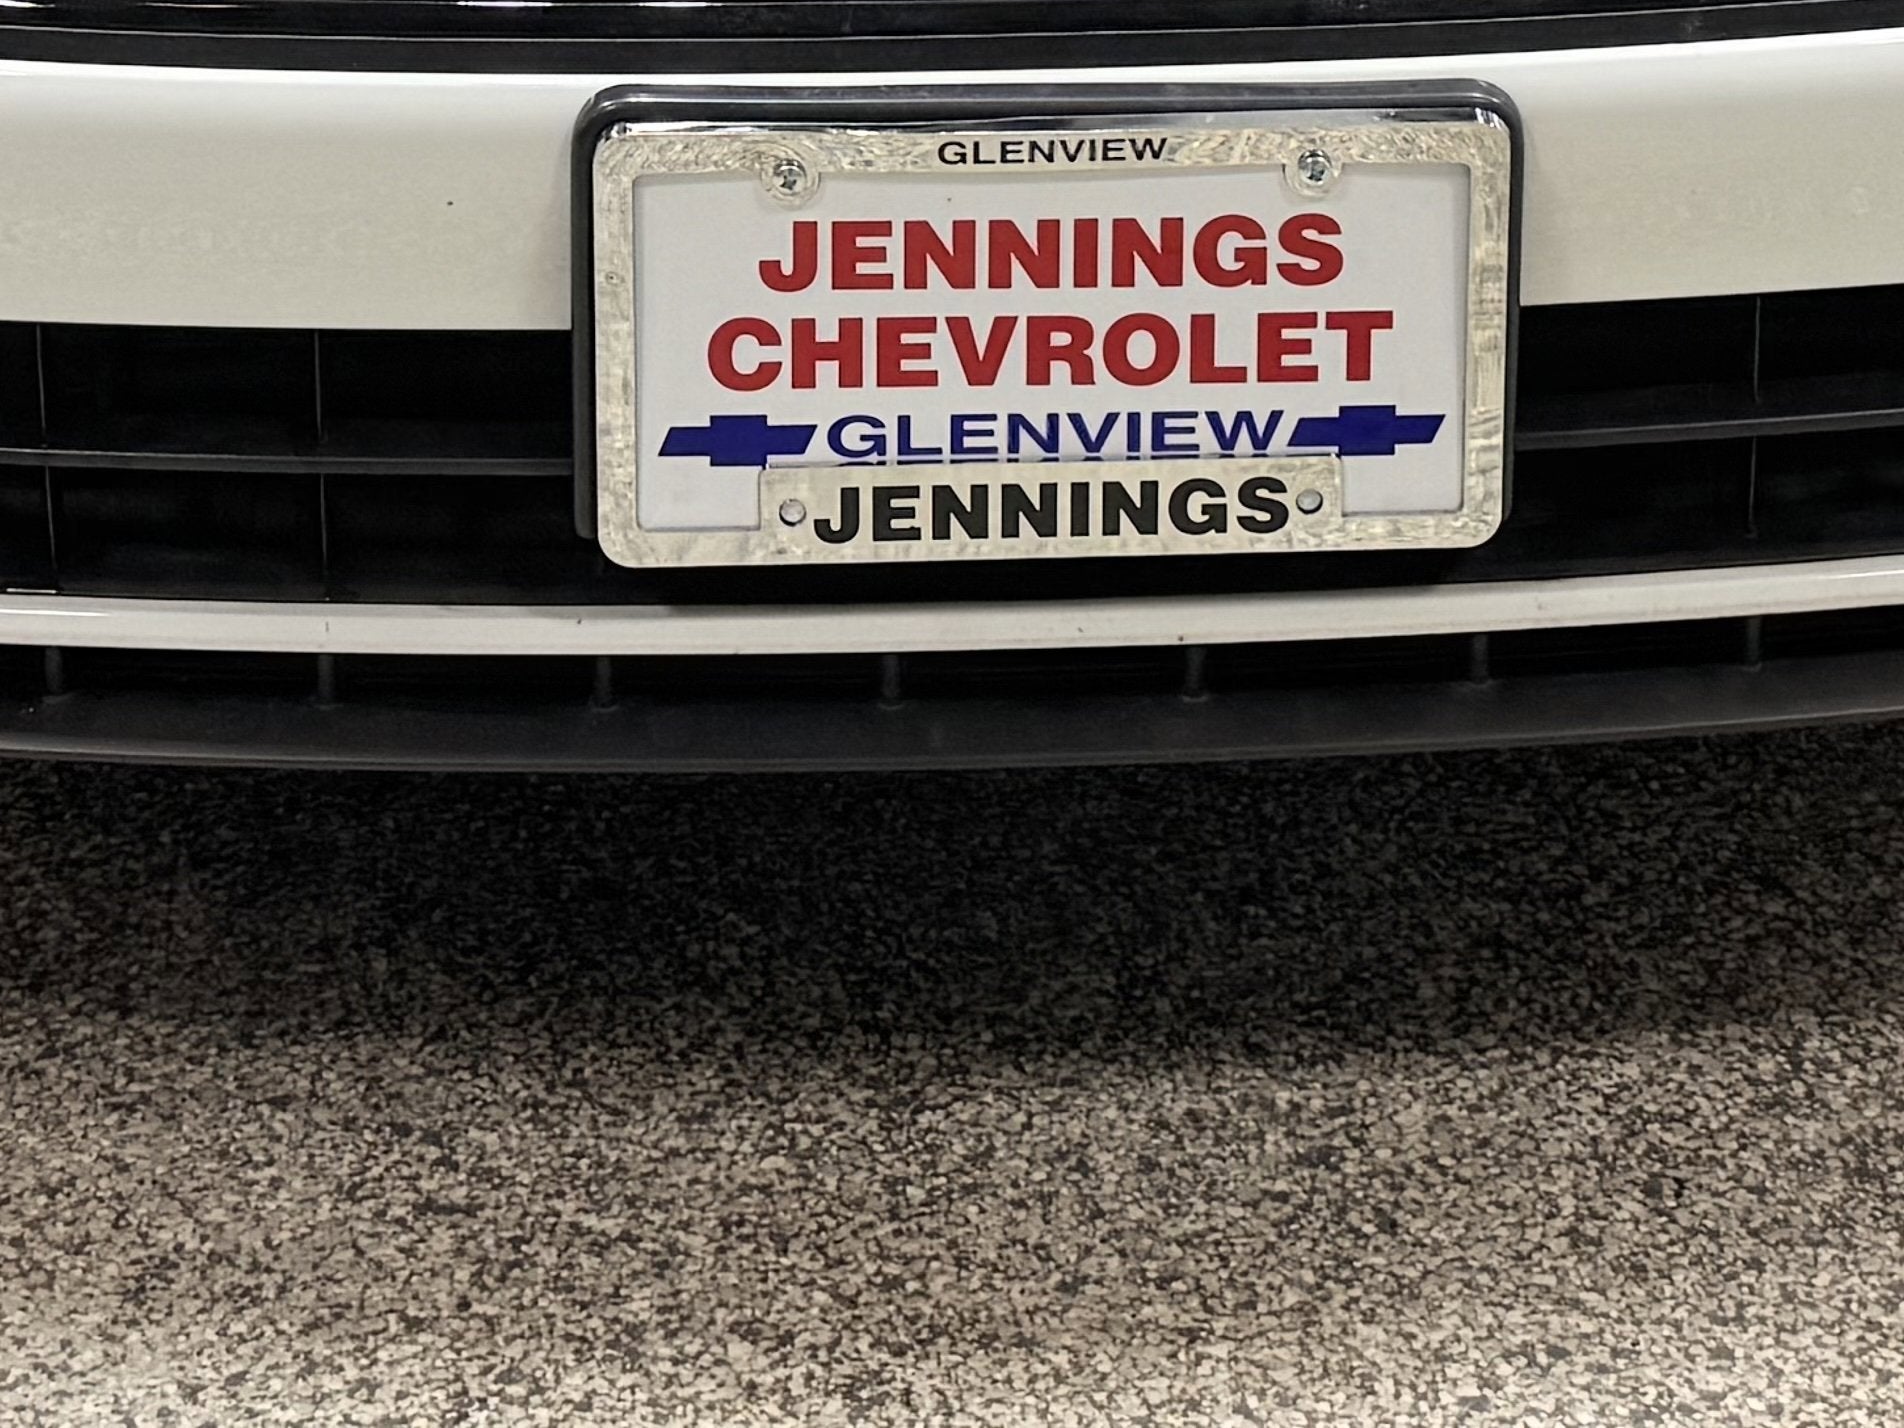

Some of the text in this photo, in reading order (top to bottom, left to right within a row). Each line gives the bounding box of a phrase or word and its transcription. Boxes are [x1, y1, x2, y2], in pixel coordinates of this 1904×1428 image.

[937, 137, 1168, 165] GLENVIEW
[759, 214, 1344, 293] JENNINGS
[707, 311, 1393, 392] CHEVROLET
[826, 409, 1285, 459] GLENVIEW
[813, 476, 1290, 544] JENNINGS
